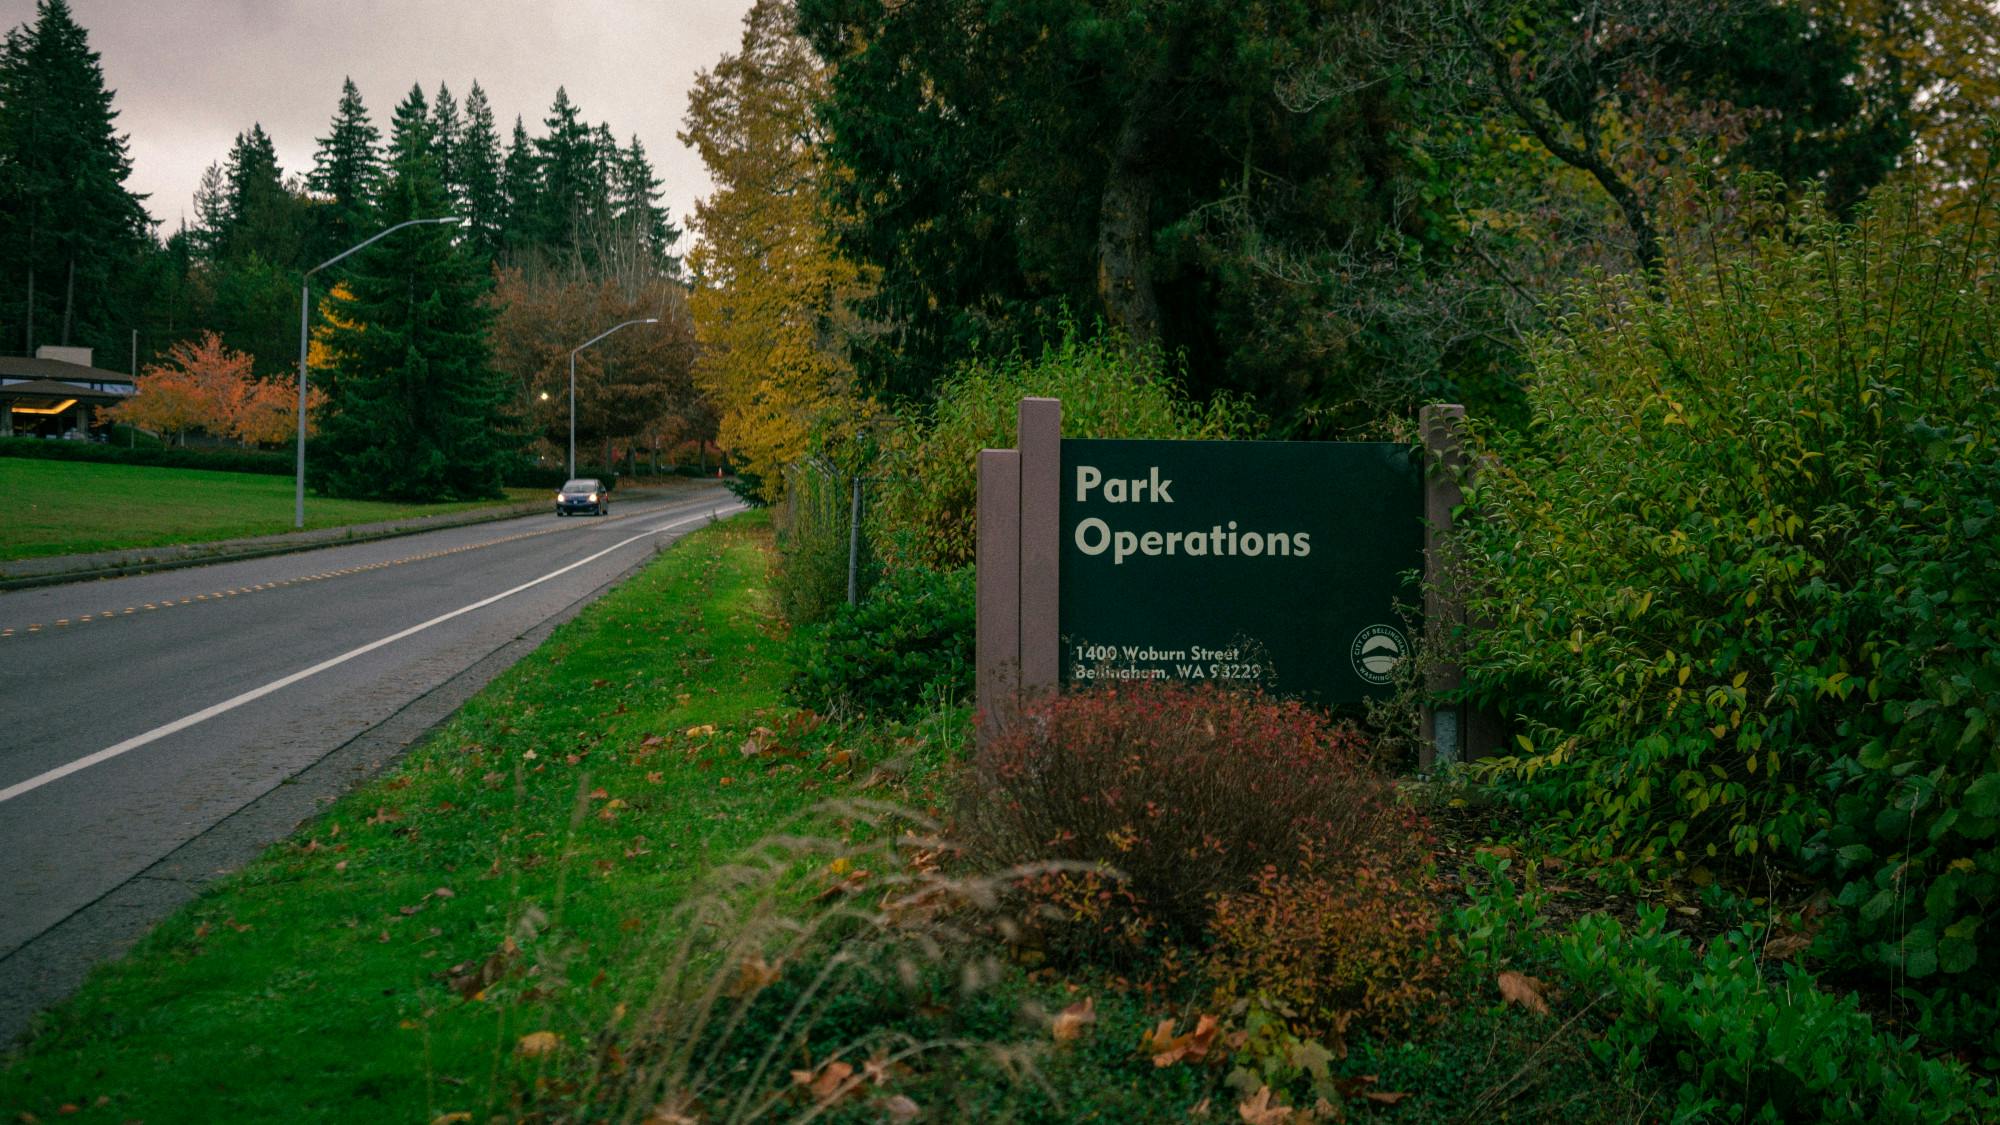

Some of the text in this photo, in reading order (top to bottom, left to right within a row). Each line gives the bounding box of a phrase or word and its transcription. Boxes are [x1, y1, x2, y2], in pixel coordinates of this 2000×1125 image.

[1076, 466, 1175, 503] Park
[1074, 517, 1311, 565] Operations
[1076, 645, 1240, 661] 1400 Woburn Street
[1354, 639, 1363, 656] CITY
[1362, 631, 1371, 640] OF
[1176, 664, 1205, 679] WA
[1359, 666, 1392, 681] WASHING
